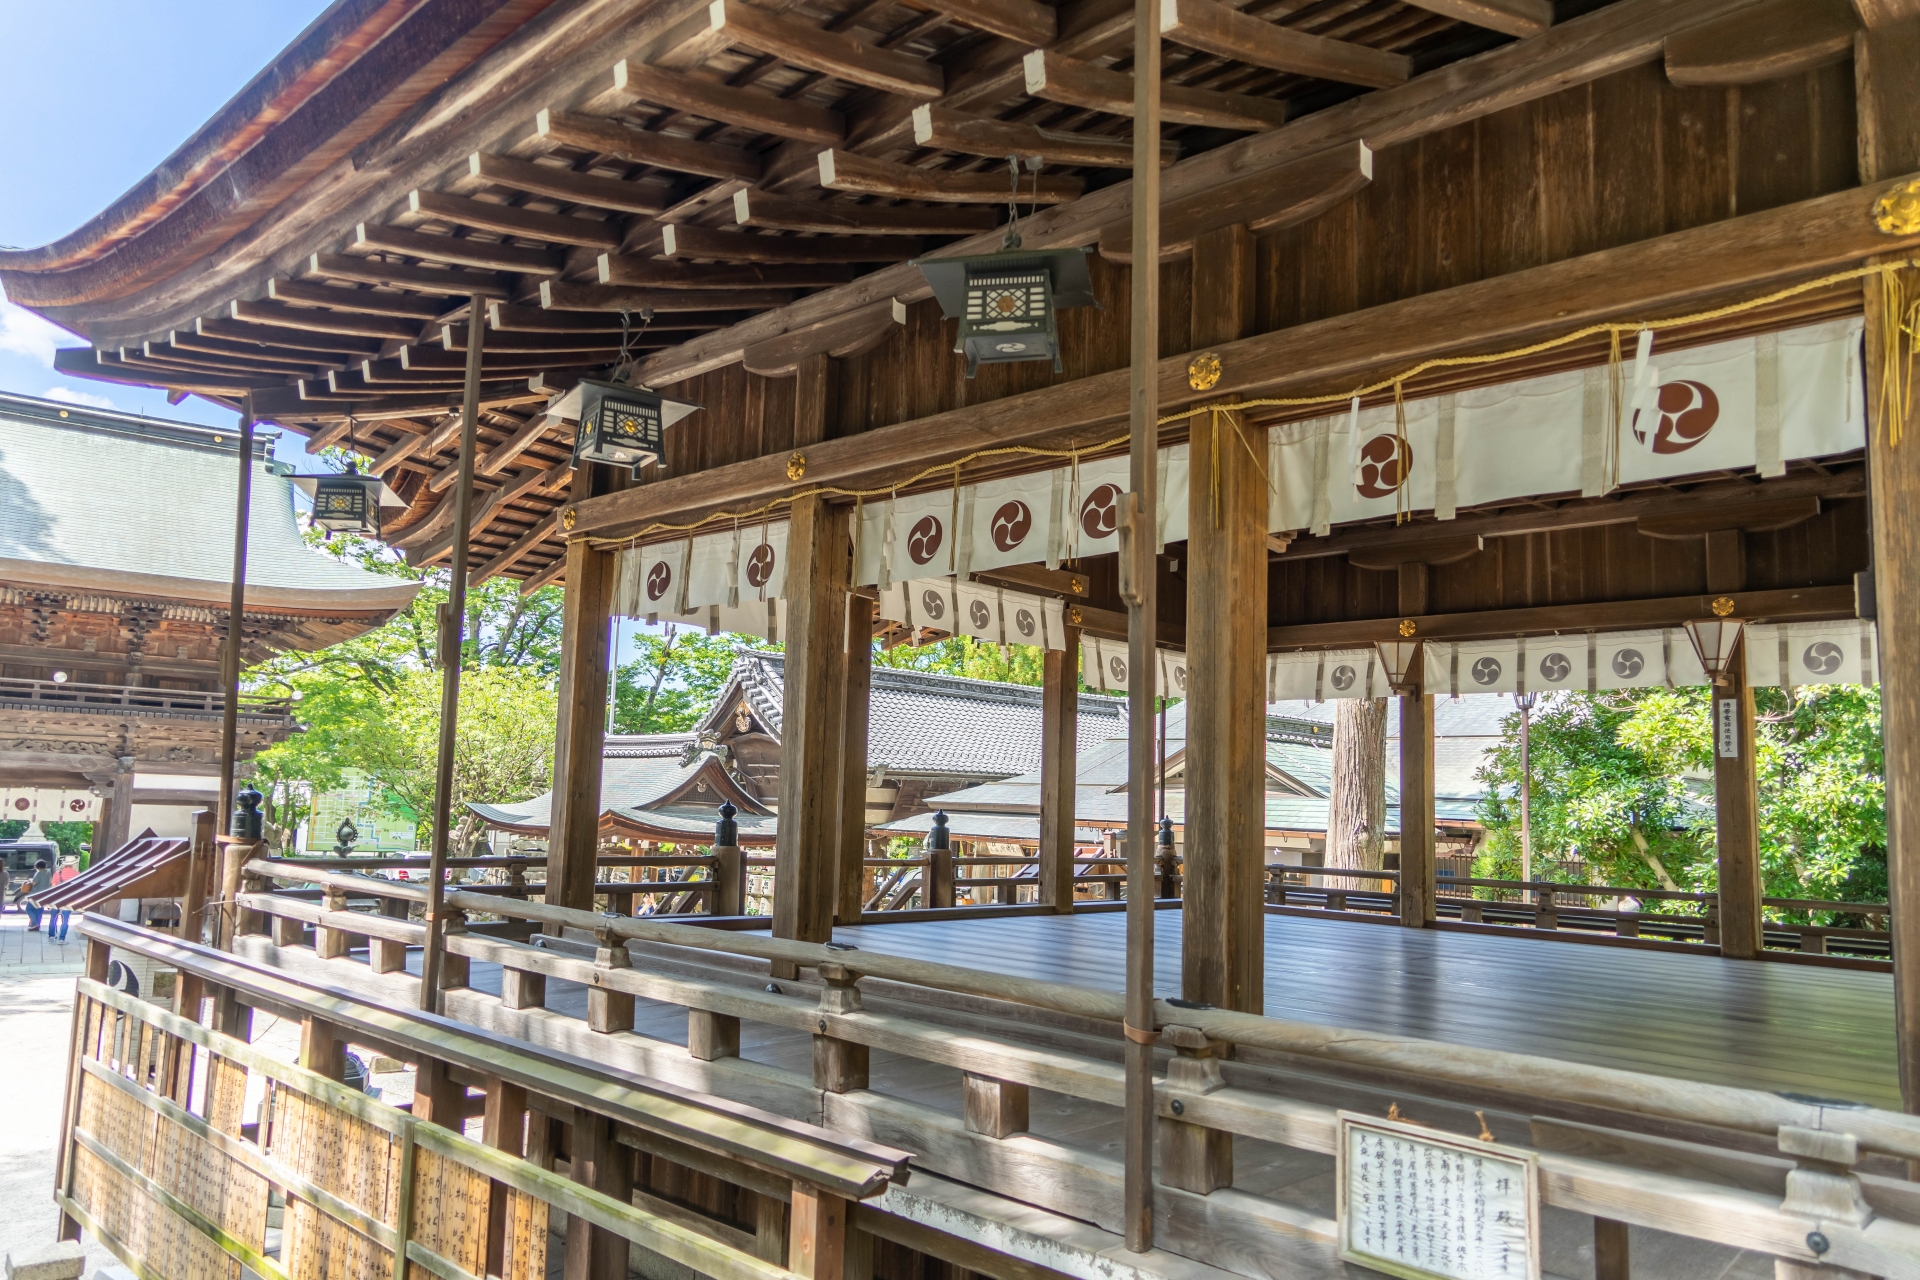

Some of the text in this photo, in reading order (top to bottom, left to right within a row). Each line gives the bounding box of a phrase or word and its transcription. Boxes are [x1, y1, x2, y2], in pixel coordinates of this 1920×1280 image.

[1723, 702, 1733, 753] 携帯電話使用禁止
[1495, 1177, 1515, 1227] 拝殿
